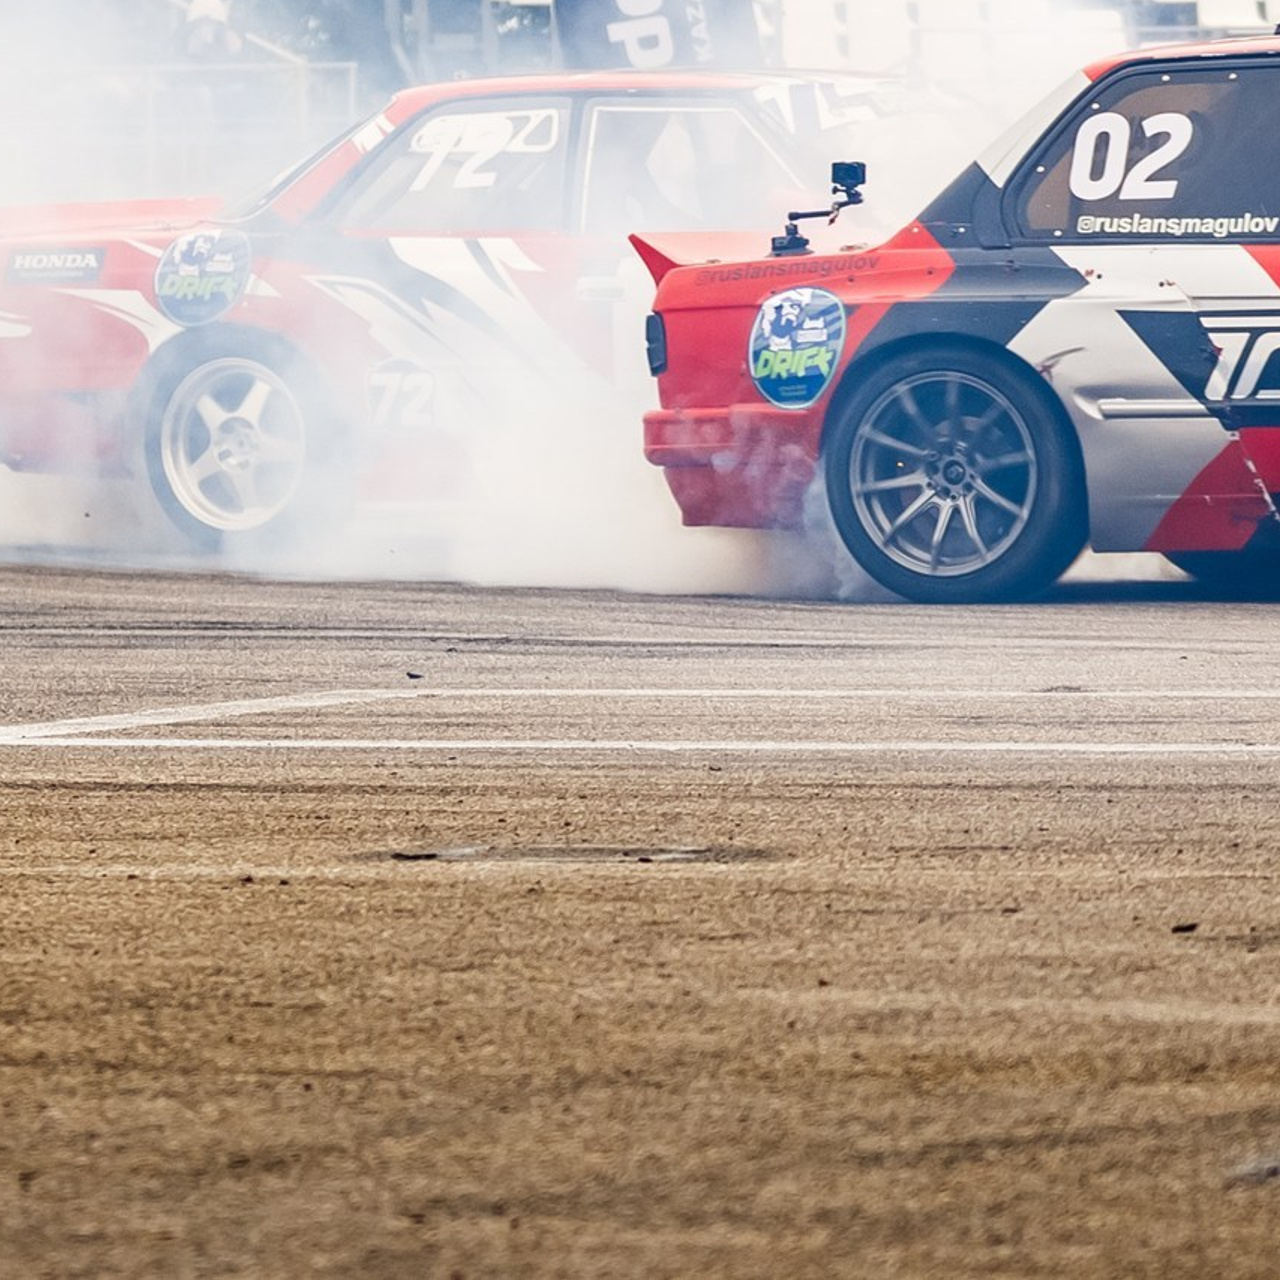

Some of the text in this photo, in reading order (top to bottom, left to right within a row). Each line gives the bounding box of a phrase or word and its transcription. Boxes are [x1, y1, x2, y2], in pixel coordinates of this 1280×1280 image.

[1069, 112, 1193, 201] 02
[1076, 213, 1280, 238] @ruslansmagulov
[13, 253, 98, 270] HONDA
[369, 372, 434, 425] 72
